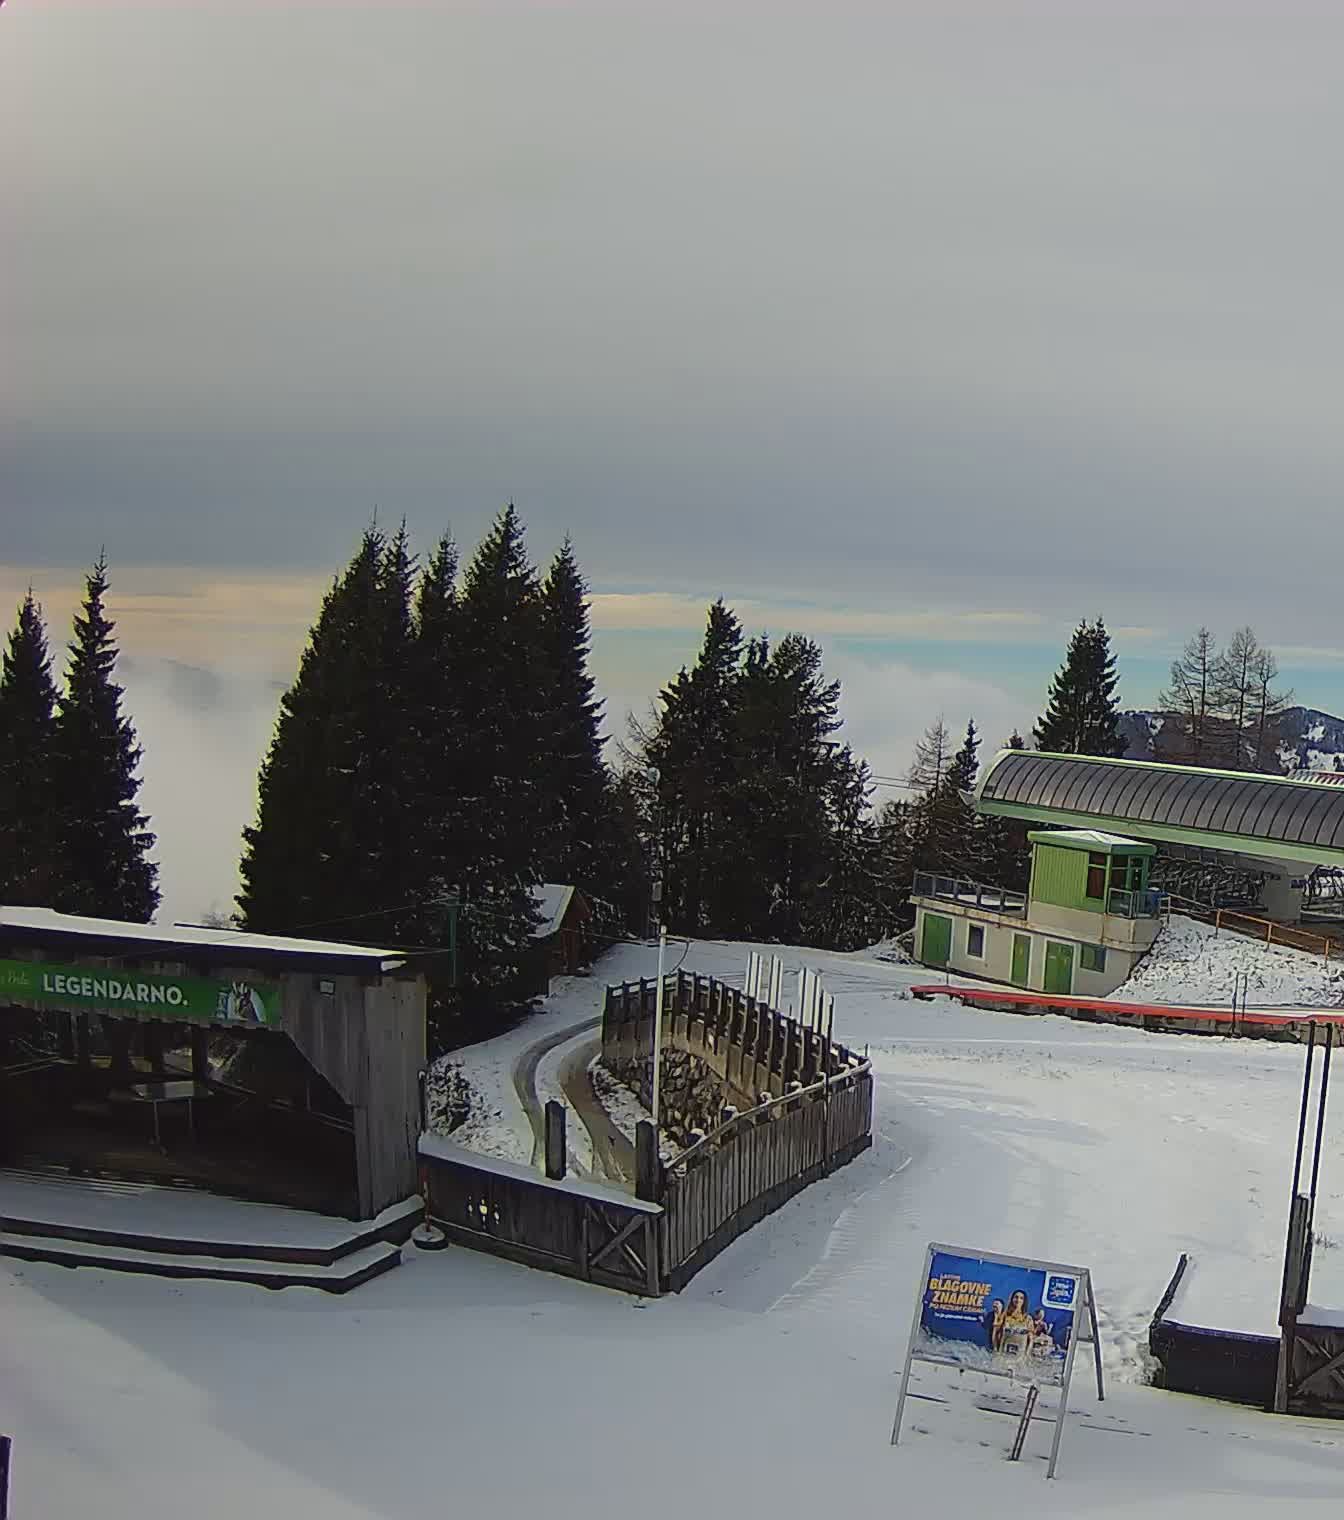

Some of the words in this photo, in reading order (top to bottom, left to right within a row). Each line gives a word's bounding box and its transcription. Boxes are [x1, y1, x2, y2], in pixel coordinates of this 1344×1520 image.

[43, 973, 188, 1006] LEGENDARNO.
[929, 1278, 992, 1296] BLAGOVNE
[932, 1290, 985, 1307] ZNAMKE
